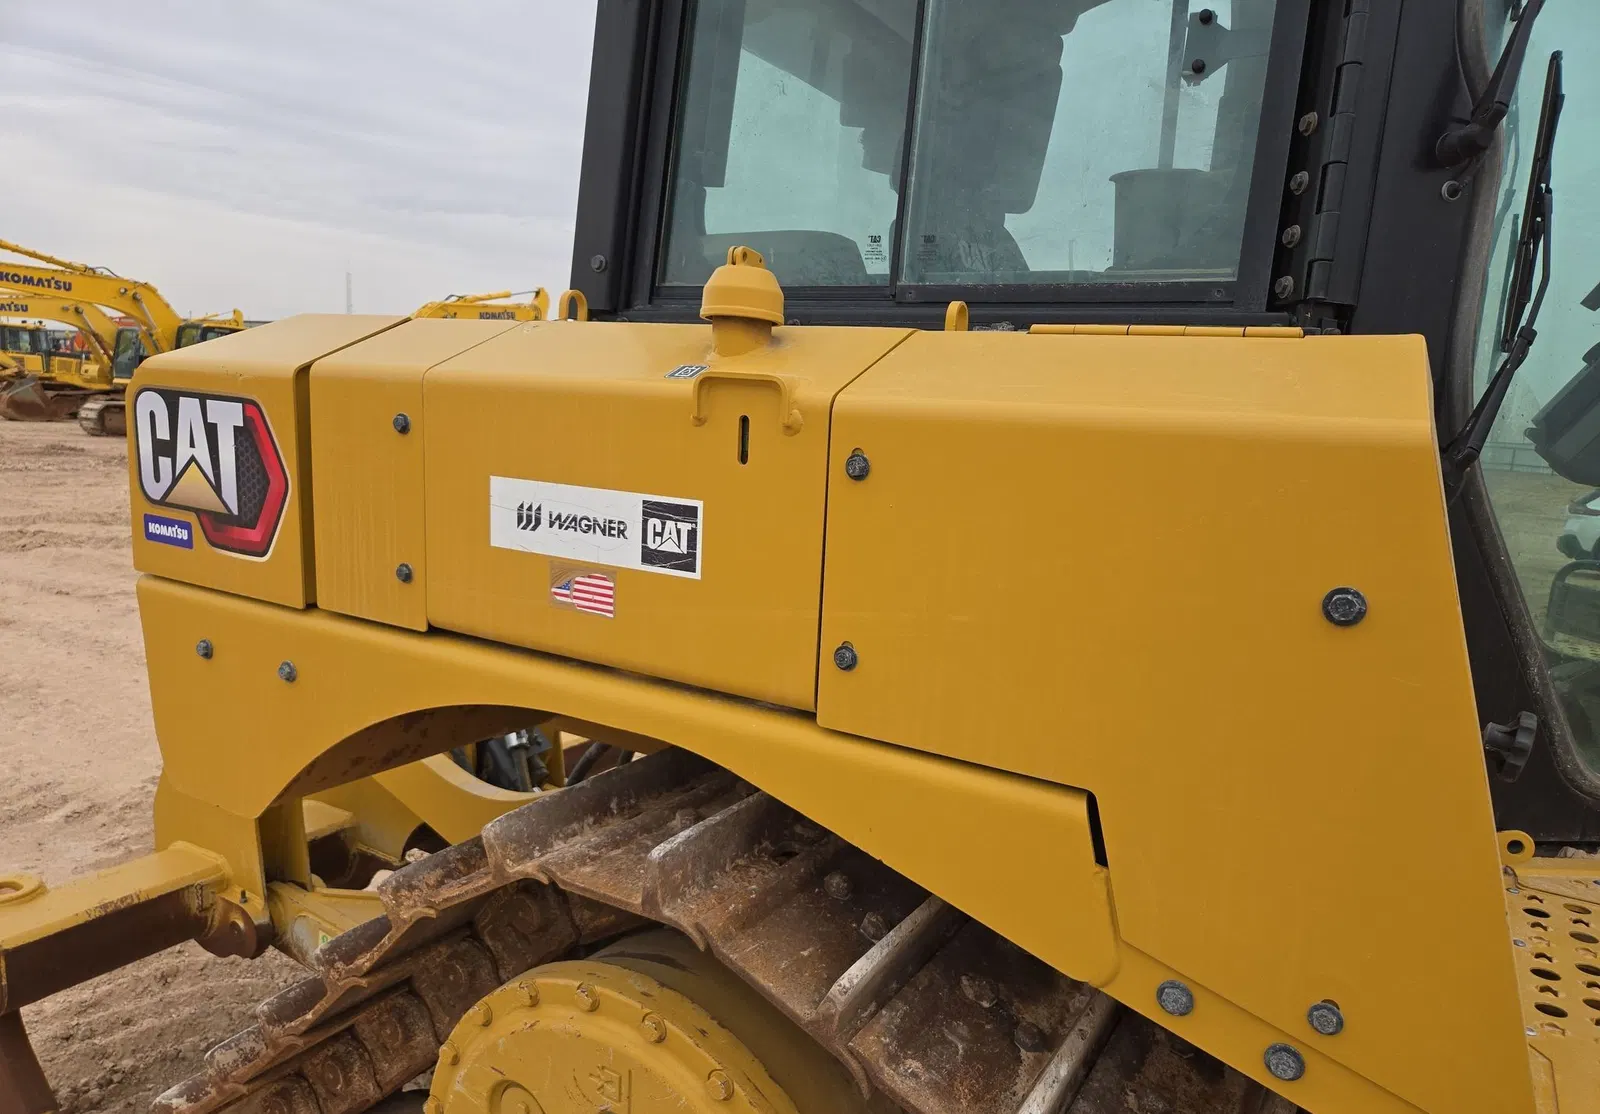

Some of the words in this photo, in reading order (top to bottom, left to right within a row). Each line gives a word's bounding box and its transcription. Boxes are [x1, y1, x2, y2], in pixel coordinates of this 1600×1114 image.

[0, 271, 72, 291] KOMATSU
[479, 310, 516, 320] KOMATSU
[136, 391, 243, 515] CAT
[148, 522, 188, 540] KOMATSU
[548, 510, 628, 539] WAGNER
[647, 517, 692, 554] CAT
